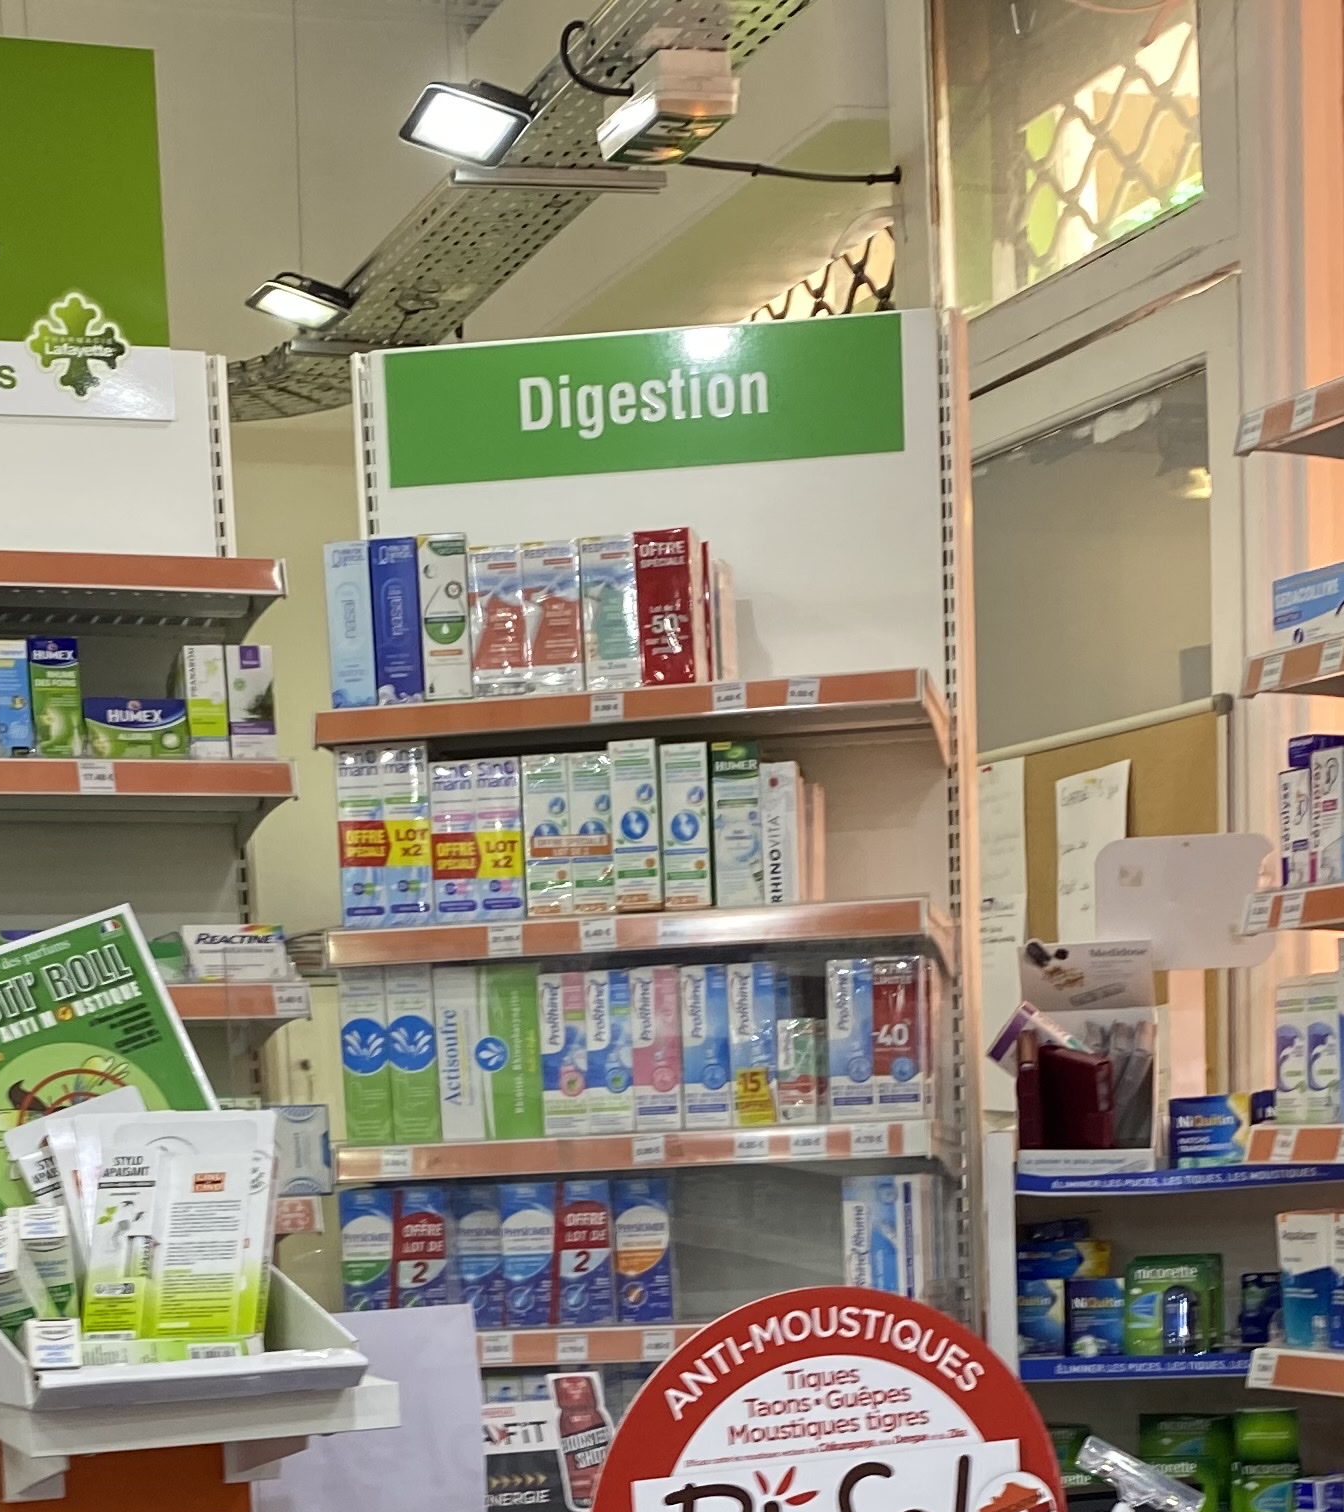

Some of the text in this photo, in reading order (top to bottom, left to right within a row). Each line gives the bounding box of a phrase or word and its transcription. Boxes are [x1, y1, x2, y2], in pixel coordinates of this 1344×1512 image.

[44, 340, 114, 358] Lafayette
[519, 368, 768, 438] Digestion
[639, 540, 685, 557] OFFRE
[34, 649, 74, 664] HUMEX
[107, 709, 163, 724] HUMEX
[715, 759, 757, 774] HUMER
[346, 830, 386, 843] OFFRE
[396, 828, 428, 841] LOT
[401, 845, 422, 857] x2
[436, 841, 476, 856] OFFRE
[485, 840, 518, 853] LOT
[492, 856, 513, 868] x2
[768, 814, 783, 903] RHINOVITA
[195, 931, 273, 946] REACTINE
[2, 955, 23, 970] des
[24, 938, 72, 967] parfums
[40, 943, 133, 1001] ROLL
[442, 1009, 462, 1105] Actisoufre
[113, 1155, 144, 1167] STYLO
[102, 1166, 150, 1178] APAISANT
[564, 1211, 607, 1228] OFFRE
[401, 1223, 443, 1238] OFFRE
[565, 1229, 608, 1243] LOT DE
[404, 1240, 425, 1254] LOT
[574, 1250, 591, 1273] 2
[412, 1261, 430, 1284] 2
[1134, 1266, 1198, 1280] nicorette
[664, 1306, 984, 1421] ANTI-MOUSTIQUES
[784, 1367, 860, 1393] Tiques
[746, 1384, 910, 1419] Taons Guêpes
[728, 1405, 929, 1446] Moustiques tigres
